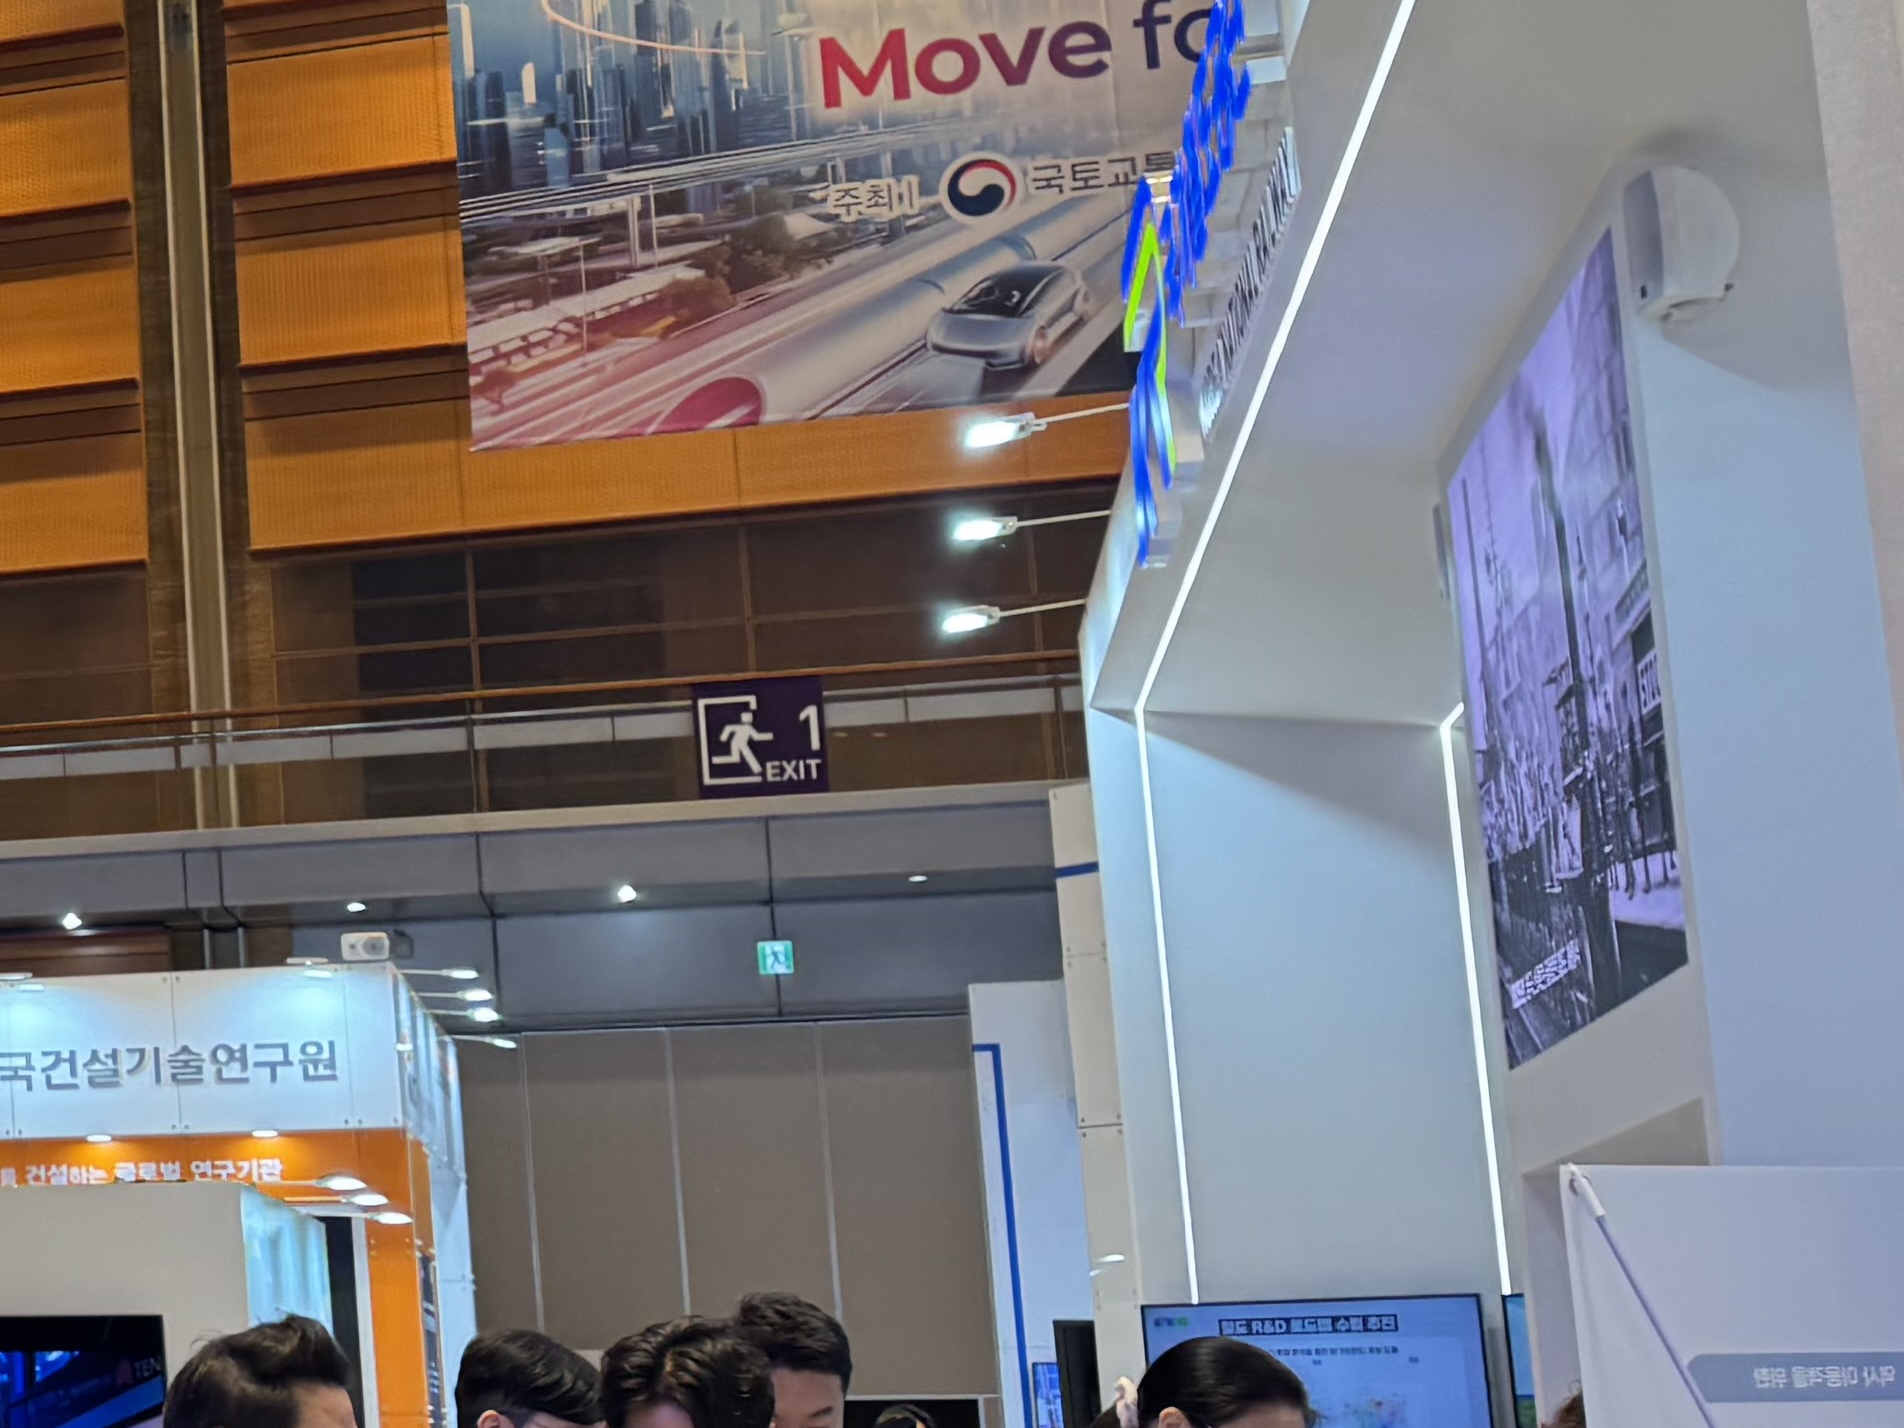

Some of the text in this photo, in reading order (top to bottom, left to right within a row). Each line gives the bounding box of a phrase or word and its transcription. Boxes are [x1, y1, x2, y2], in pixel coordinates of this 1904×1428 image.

[820, 20, 1112, 110] Move
[833, 151, 1176, 217] 주최 국토교통
[798, 705, 822, 752] 1
[765, 758, 821, 783] EXIT
[24, 1162, 110, 1186] 건설하는
[113, 1160, 182, 1184] 글로벌
[190, 1157, 284, 1183] 연구기관
[1251, 1319, 1287, 1334] R&D
